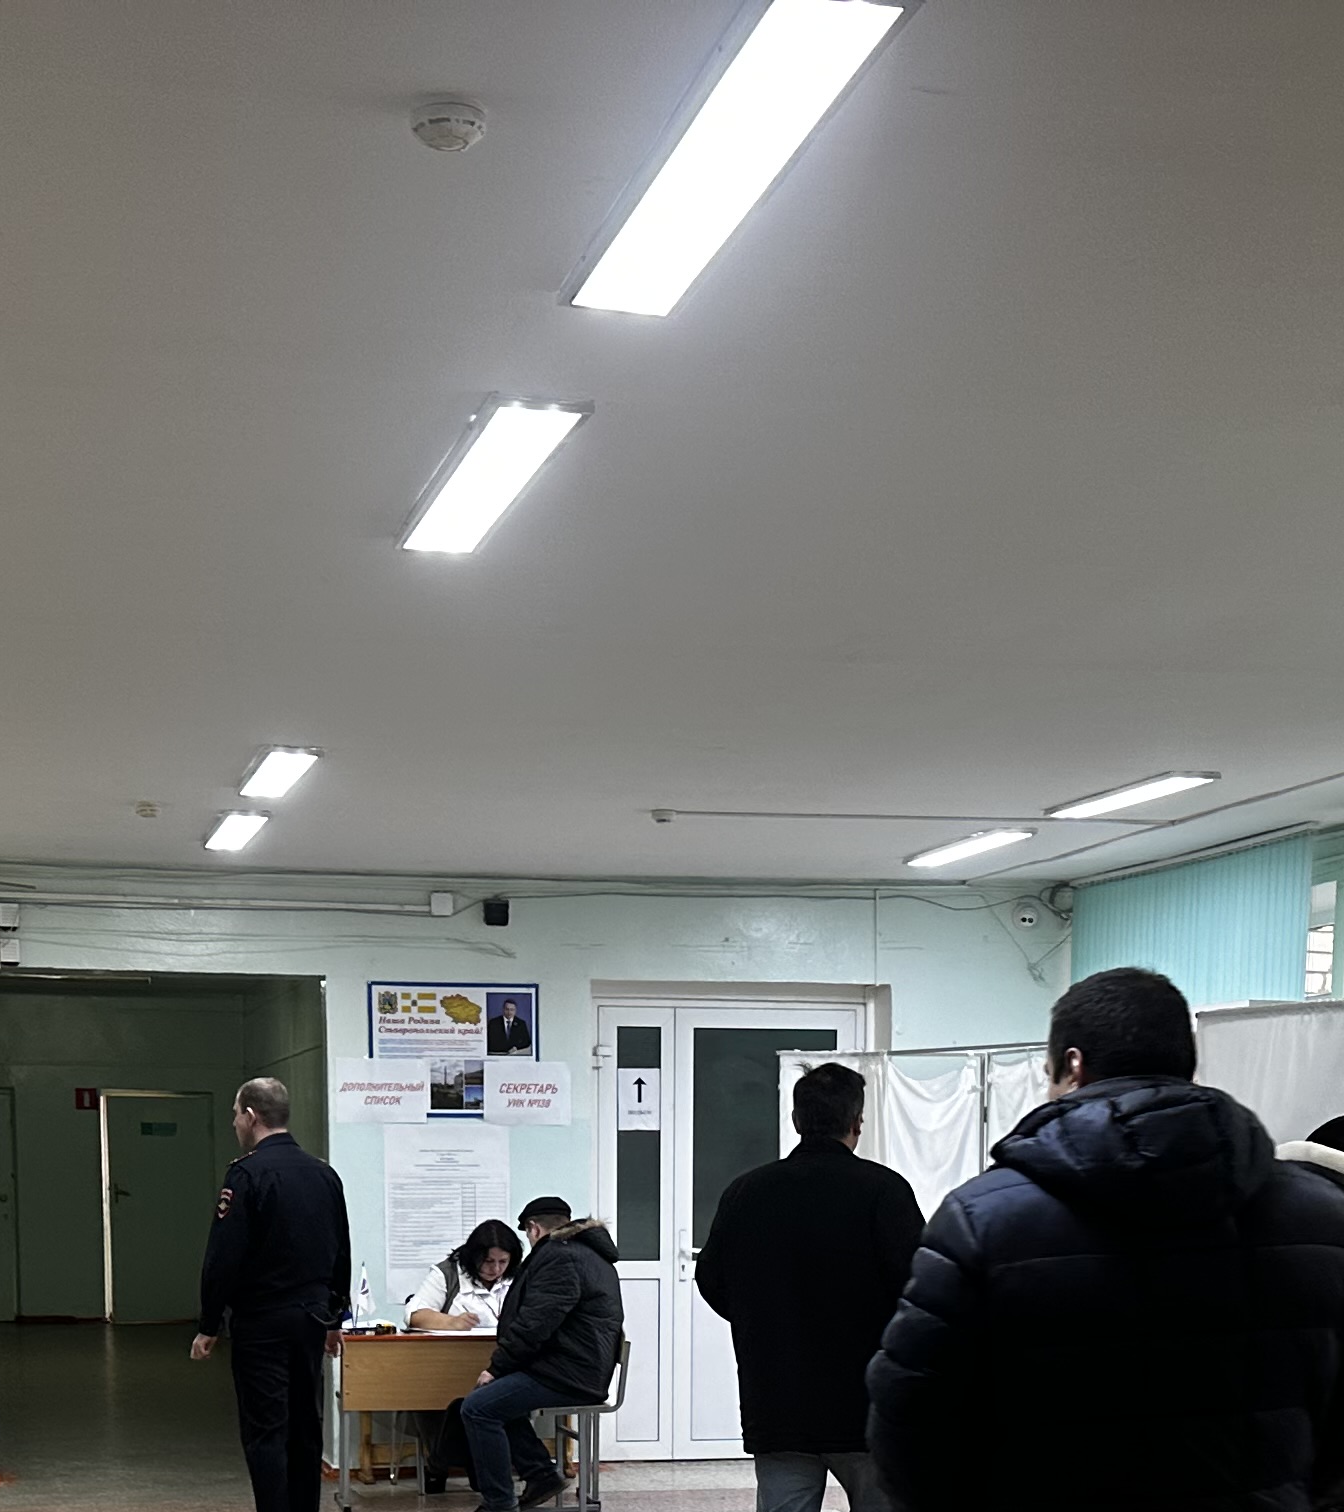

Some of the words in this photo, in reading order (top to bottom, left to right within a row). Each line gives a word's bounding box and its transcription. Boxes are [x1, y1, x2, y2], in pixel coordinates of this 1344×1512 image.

[339, 1080, 425, 1093] ДОПОЛНИТЕЛЬНЫЙ
[498, 1083, 558, 1095] СЕКРЕТАРЬ
[364, 1095, 403, 1106] СПИСОК
